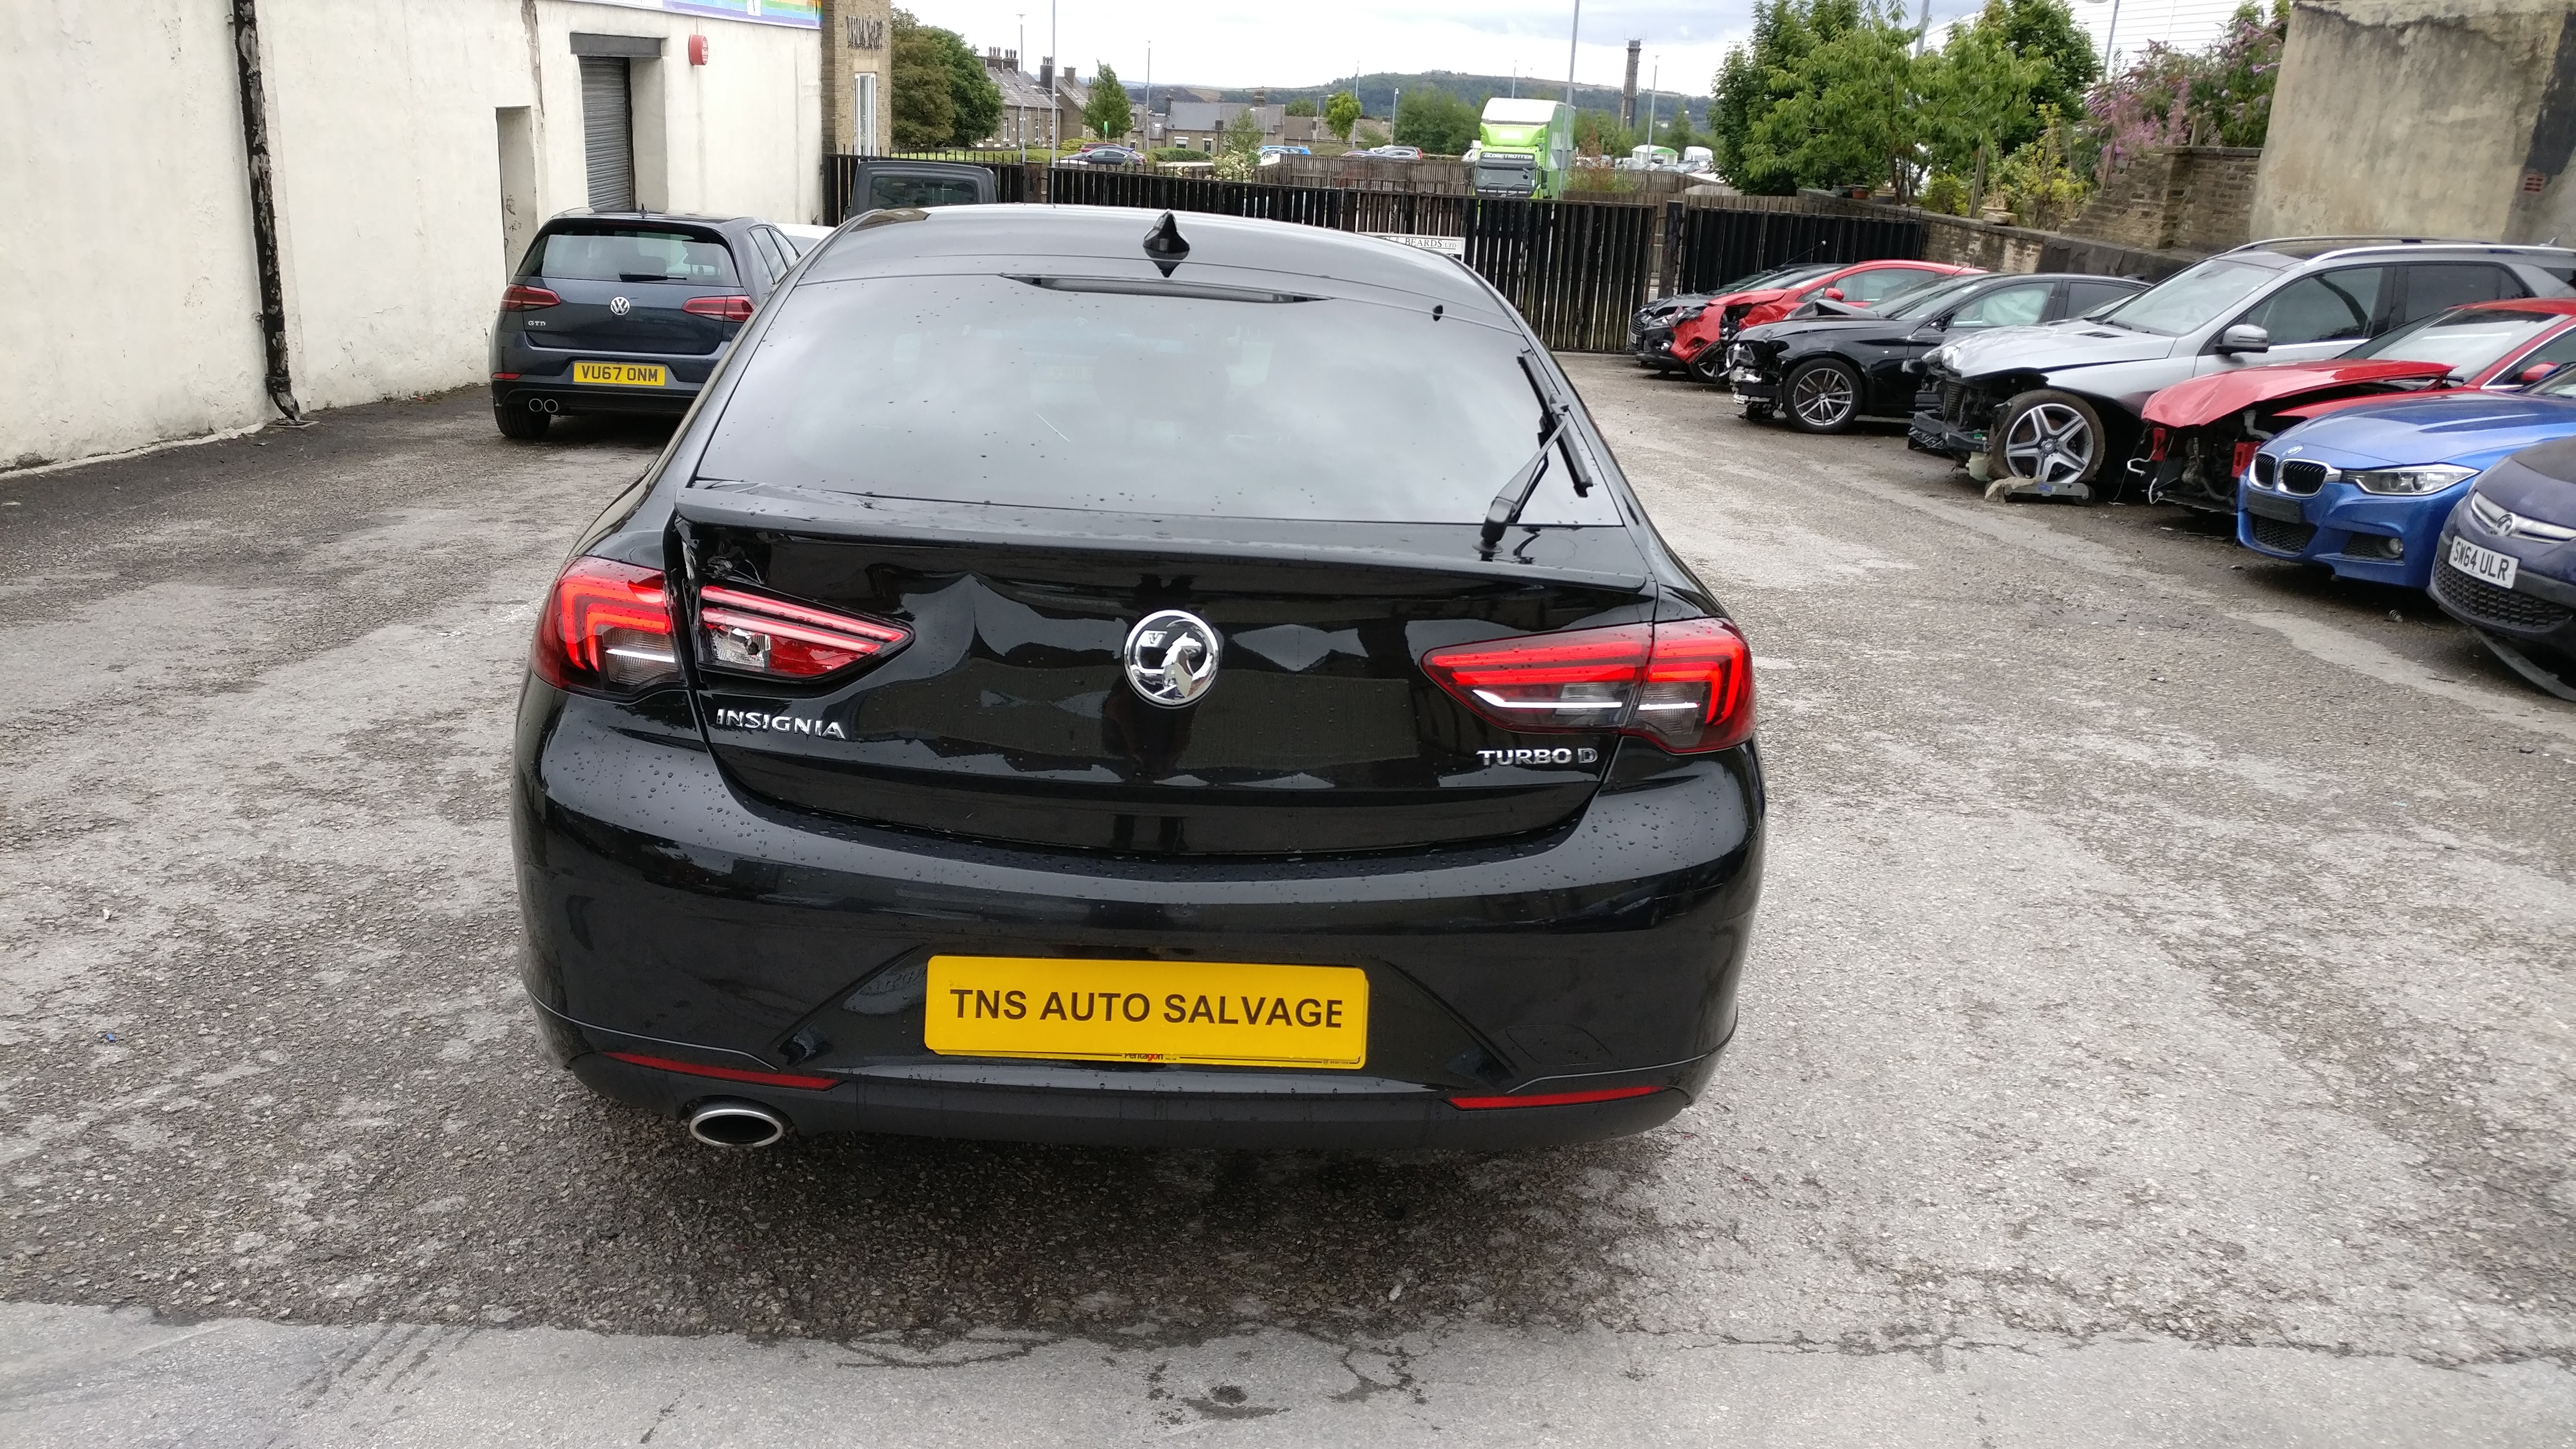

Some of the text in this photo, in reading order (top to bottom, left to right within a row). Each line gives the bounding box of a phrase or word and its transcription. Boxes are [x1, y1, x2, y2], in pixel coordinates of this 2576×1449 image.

[1405, 238, 1442, 248] BEARDS
[581, 365, 622, 381] VU67
[2454, 541, 2509, 581] SW64 ULR
[716, 709, 846, 739] INSIGNIA
[1476, 748, 1598, 766] TURBO D
[950, 989, 1343, 1028] TNS AUTO SALVAGE
